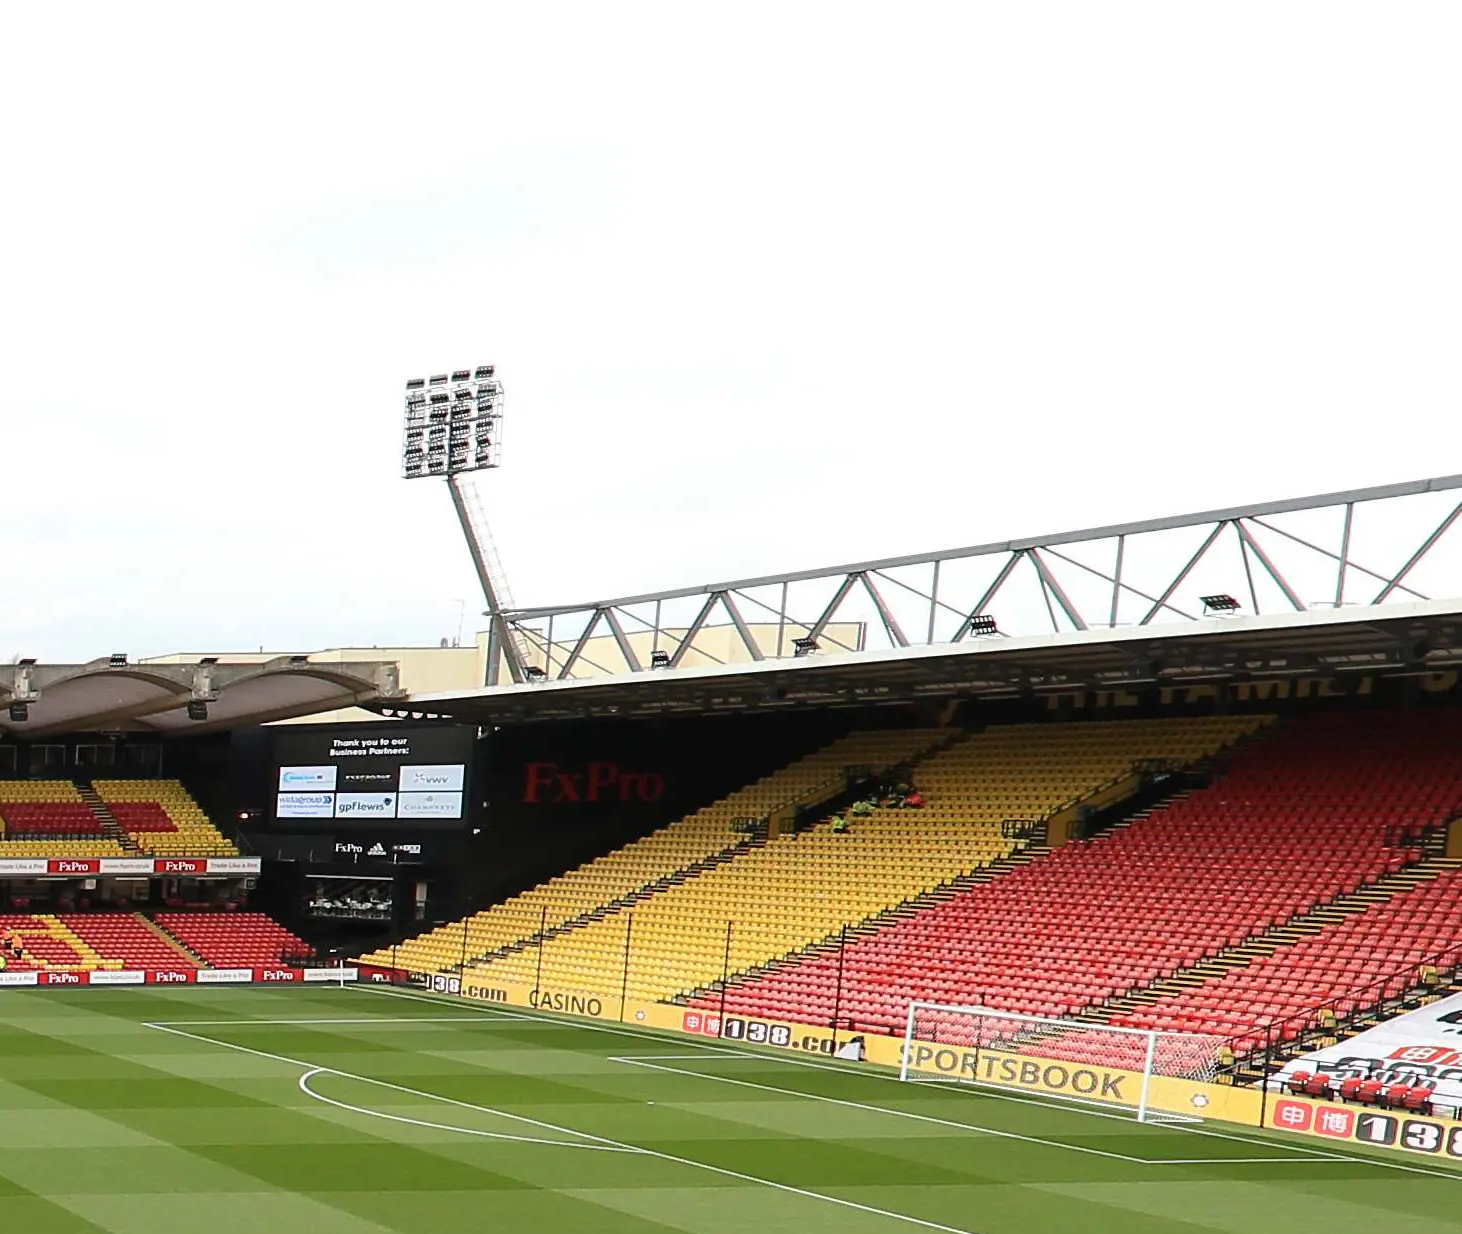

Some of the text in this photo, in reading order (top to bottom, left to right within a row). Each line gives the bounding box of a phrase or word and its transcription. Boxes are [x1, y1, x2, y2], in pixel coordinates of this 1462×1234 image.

[333, 739, 360, 747] Thank
[362, 739, 378, 748] you
[329, 748, 367, 757] Business
[522, 761, 666, 804] FxPro
[335, 843, 363, 853] FxPro
[59, 862, 88, 871] FxPro
[166, 861, 195, 871] FxPro
[49, 973, 78, 983] FxPro
[156, 972, 186, 982] FxPro
[263, 970, 294, 981] FxPro
[529, 990, 602, 1016] CASINO
[727, 1020, 852, 1056] 138.co
[898, 1043, 1126, 1100] SPORTSBOOK
[1279, 1105, 1351, 1134] 申博
